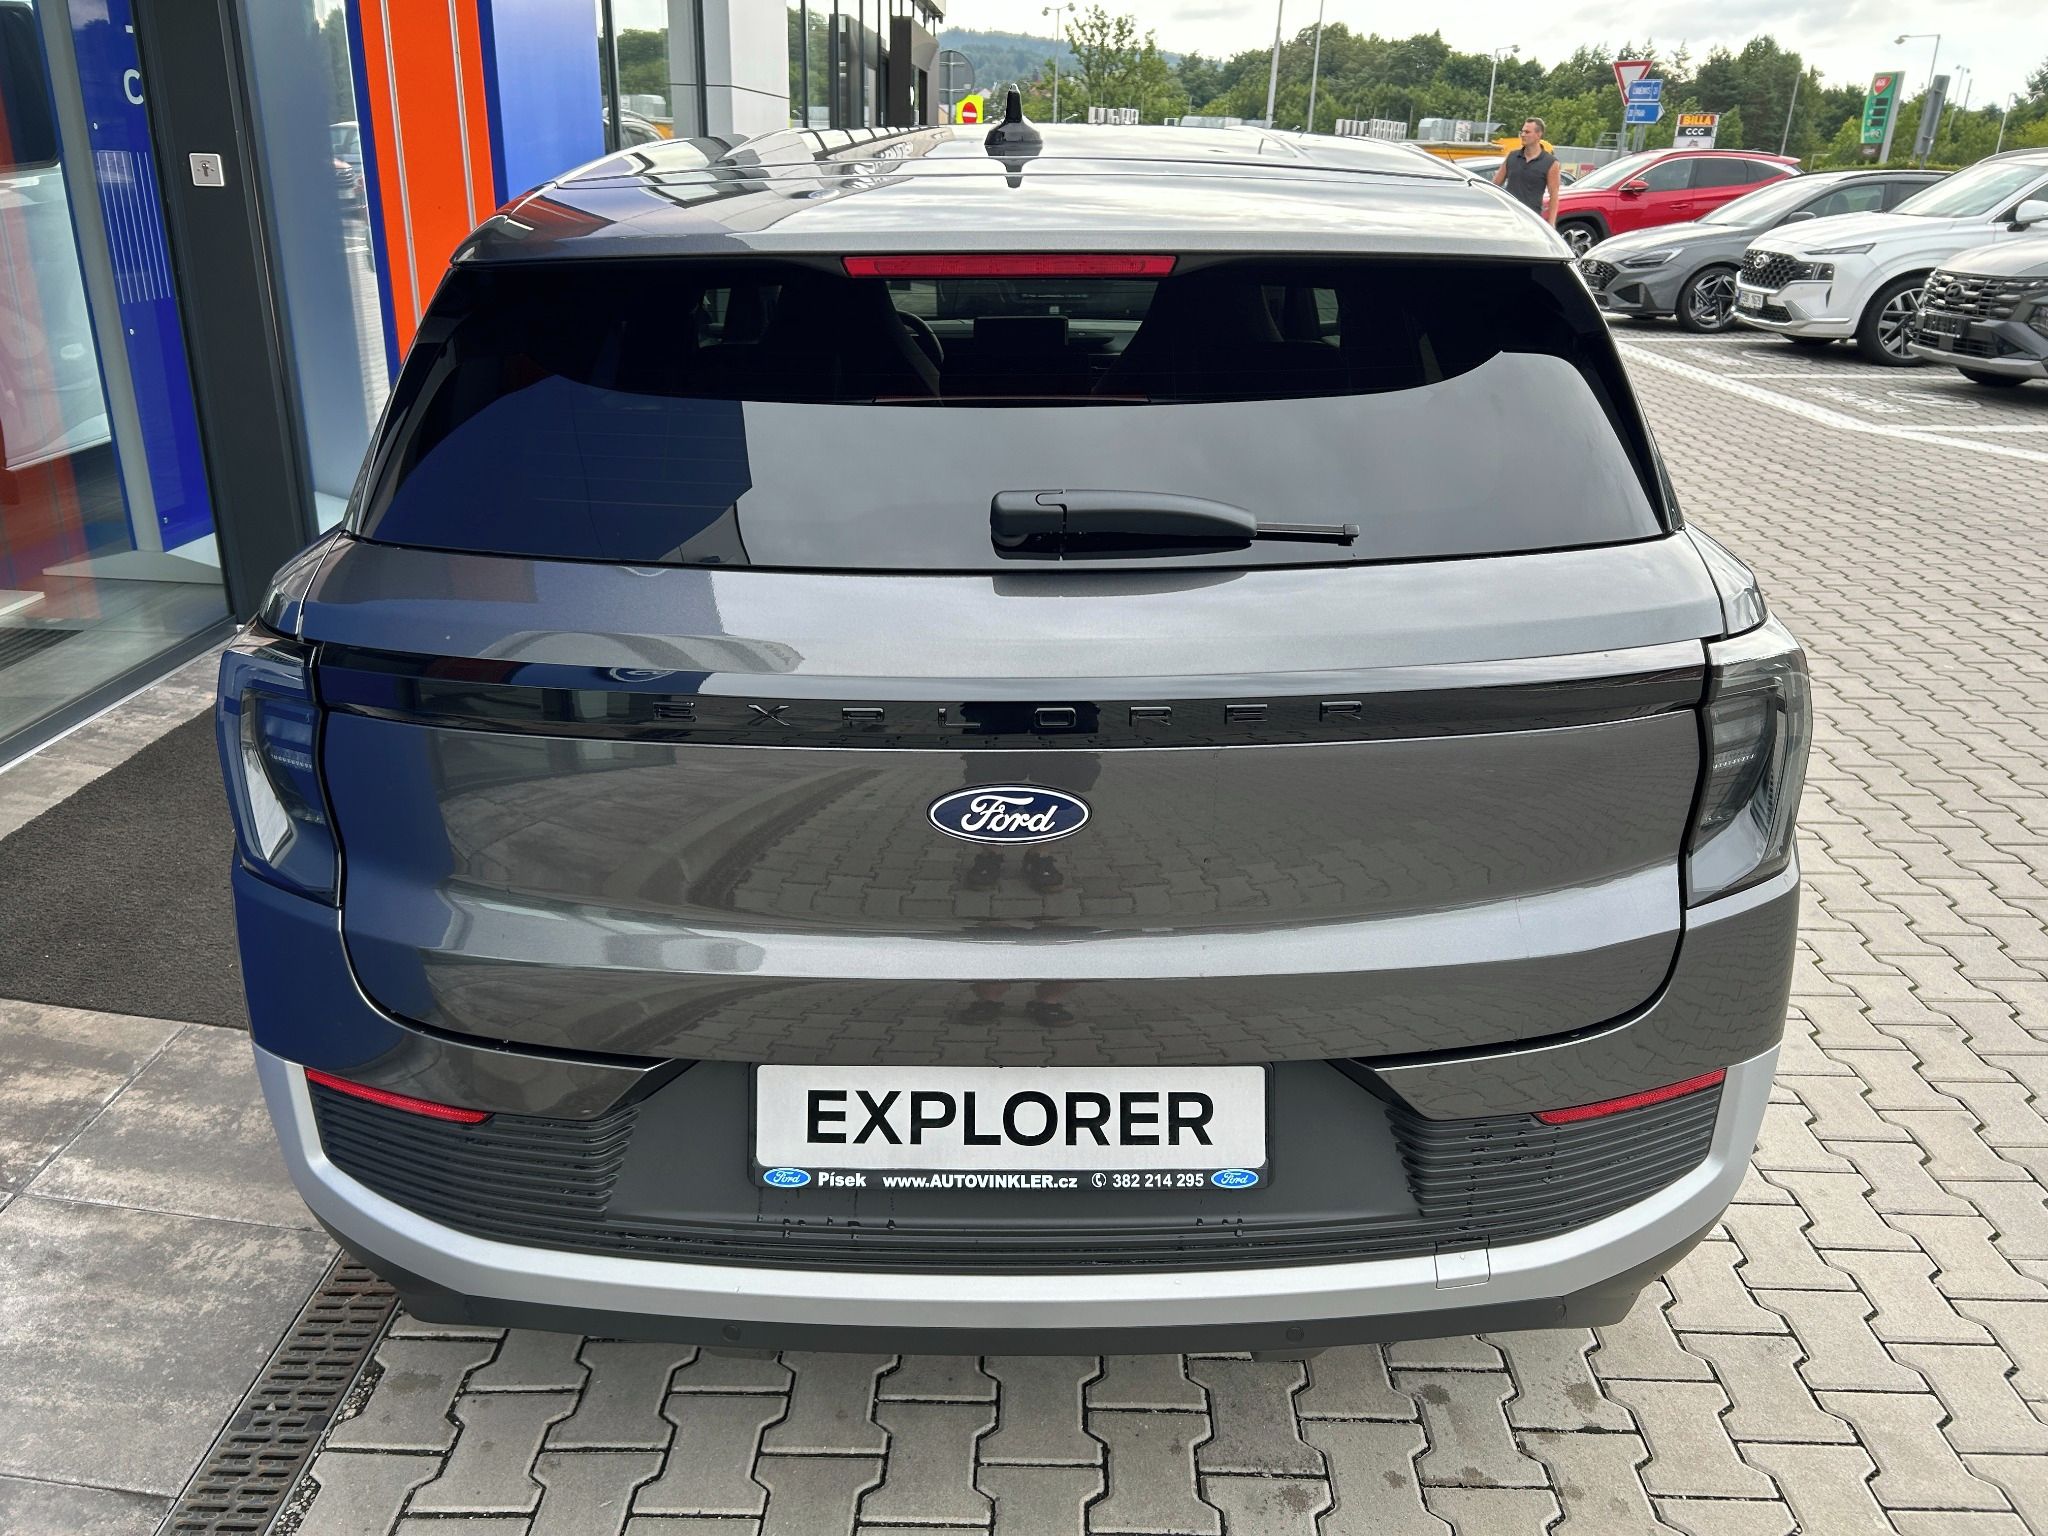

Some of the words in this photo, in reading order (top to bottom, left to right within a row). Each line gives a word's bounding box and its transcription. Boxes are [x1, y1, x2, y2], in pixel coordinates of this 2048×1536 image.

[1683, 115, 1712, 125] BILLA
[1685, 127, 1705, 136] CCC
[652, 700, 1363, 729] EXPLORER
[960, 794, 1059, 832] Ford
[806, 1089, 1214, 1147] EXPLORER
[773, 1170, 801, 1183] Ford
[818, 1171, 867, 1187] Písek
[883, 1173, 1078, 1188] www.AUTOVINKLER.cz
[1113, 1173, 1141, 1188] 382
[1145, 1173, 1173, 1188] 214
[1177, 1173, 1204, 1187] 295
[1221, 1171, 1249, 1184] Ford
